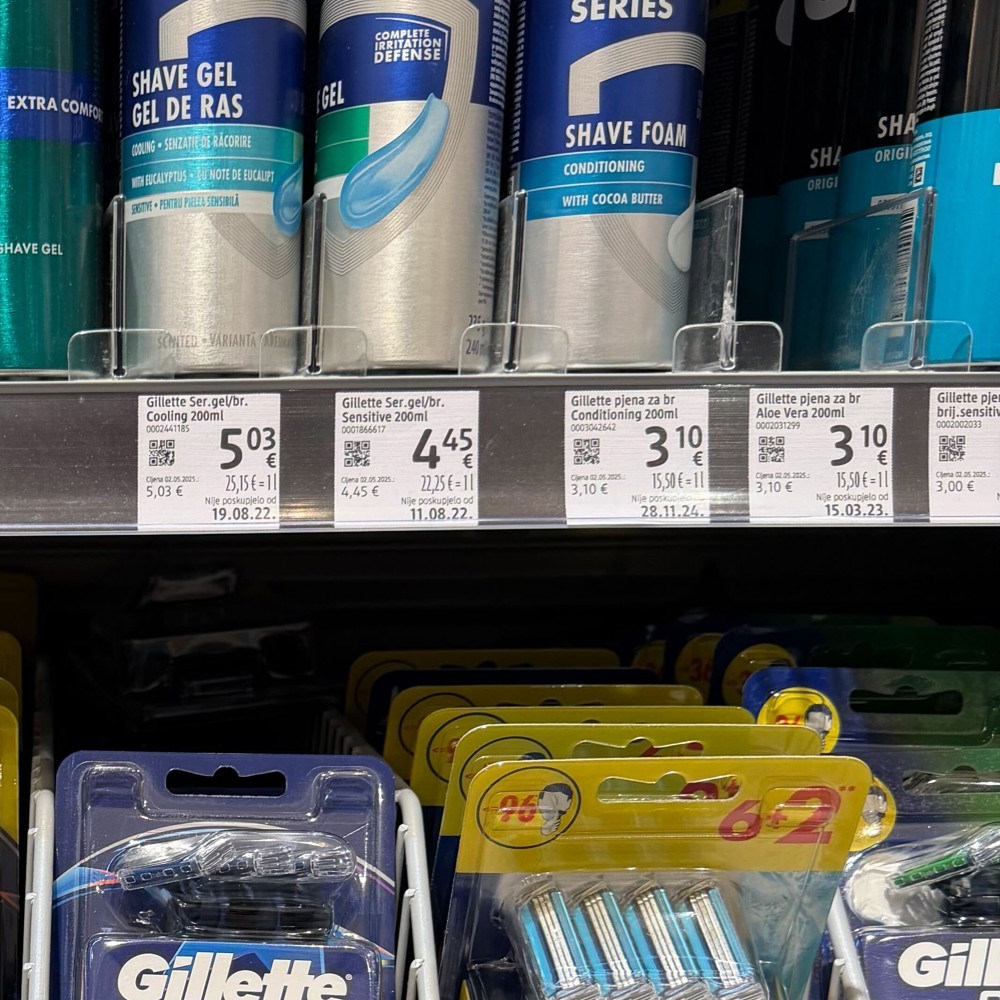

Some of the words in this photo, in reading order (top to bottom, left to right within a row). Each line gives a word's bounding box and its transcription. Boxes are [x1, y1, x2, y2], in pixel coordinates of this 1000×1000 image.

[375, 29, 430, 40] COMPLETE
[375, 39, 441, 51] IRRITATION
[374, 49, 440, 64] DEFENSE
[132, 63, 188, 97] SHAVE
[197, 62, 236, 87] GEL
[8, 96, 58, 111] EXTRA
[132, 100, 159, 128] GEL
[167, 95, 191, 121] DE
[200, 94, 243, 119] RAS
[566, 121, 633, 148] SHAVE
[642, 121, 687, 148] FOAM
[564, 160, 645, 176] CONDITIONING
[563, 194, 588, 207] WITH
[592, 193, 627, 205] COCOA
[632, 193, 662, 205] BUTTER
[41, 244, 62, 256] GEL
[147, 397, 186, 407] Gillette
[342, 397, 382, 408] Gillette
[572, 396, 611, 406] Gillette
[615, 395, 644, 408] pjena
[648, 396, 659, 405] za
[664, 394, 675, 404] br
[757, 394, 796, 404] Gillette
[800, 393, 830, 406] pjena
[834, 395, 845, 403] za
[849, 393, 860, 403] br
[938, 392, 977, 403] Gillette
[147, 411, 187, 423] Cooling
[191, 410, 224, 421] 200ml
[342, 412, 391, 422] Sensitive
[395, 411, 428, 421] 200ml
[572, 409, 641, 422] Conditioning
[645, 408, 678, 419] 200ml
[756, 408, 781, 418] Aloe
[784, 408, 808, 418] Vera
[812, 407, 844, 418] 200ml
[213, 508, 275, 520] 19.08.22.
[411, 508, 472, 519] 11.08.22.
[642, 506, 704, 516] 28.11.24.
[825, 504, 888, 516] 15.03.23.
